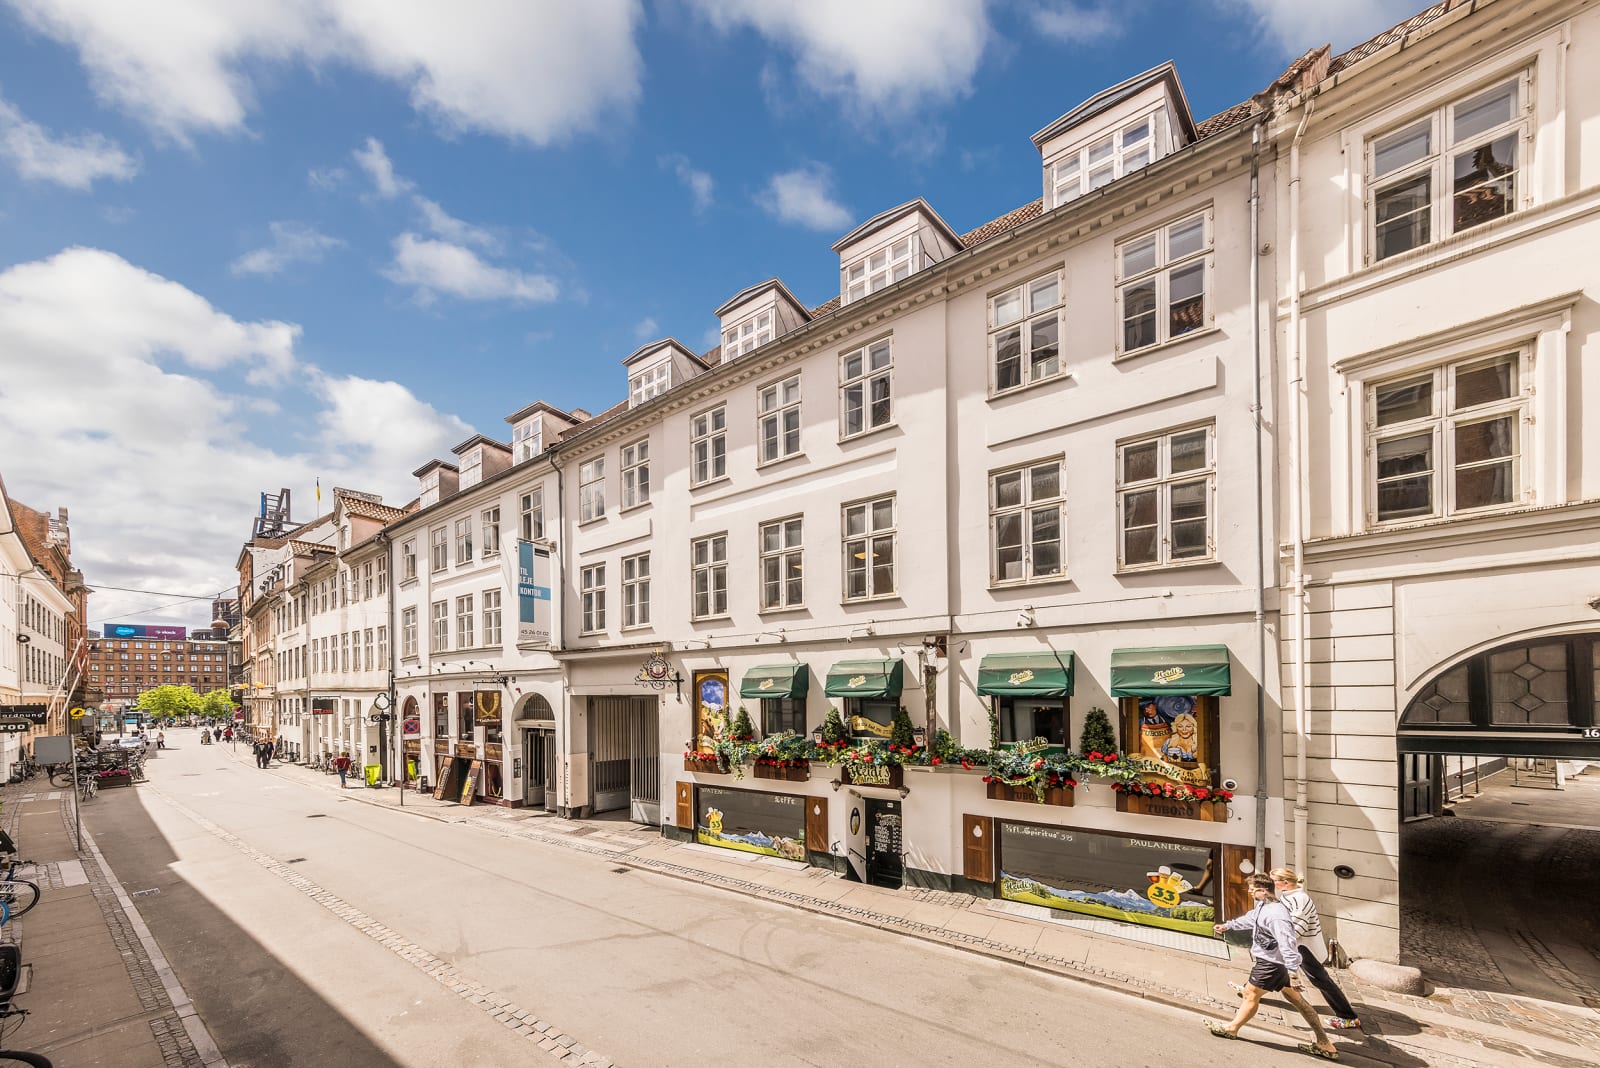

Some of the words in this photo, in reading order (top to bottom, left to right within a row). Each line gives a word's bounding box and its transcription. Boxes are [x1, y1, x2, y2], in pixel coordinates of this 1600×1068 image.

[1584, 729, 1600, 738] 16
[1129, 838, 1181, 851] PAULANER
[1152, 886, 1175, 902] 33
